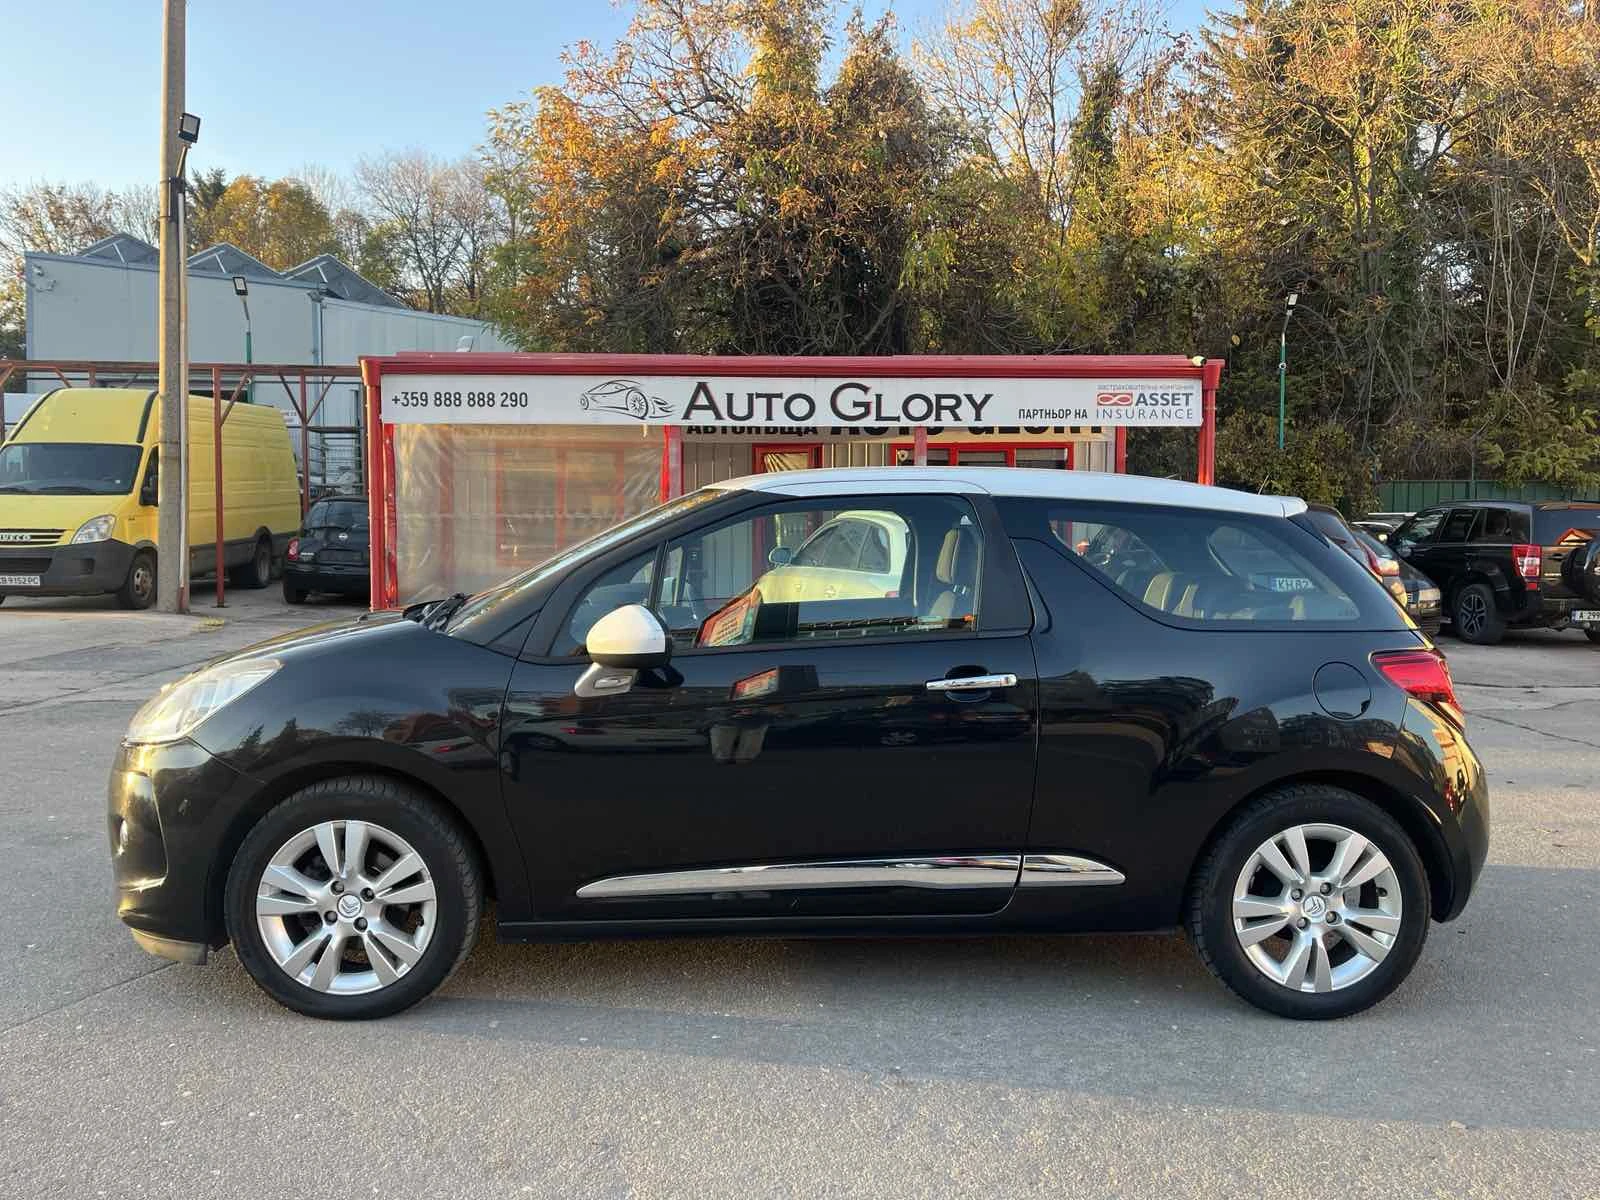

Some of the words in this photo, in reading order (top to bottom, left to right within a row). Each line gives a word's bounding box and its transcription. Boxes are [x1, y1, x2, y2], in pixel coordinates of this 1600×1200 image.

[391, 391, 428, 407] +359
[433, 391, 462, 407] 888
[467, 391, 496, 407] 888
[500, 391, 528, 407] 290
[1135, 392, 1193, 407] ASSET
[1018, 408, 1071, 420] ПАРТНЬОР
[1074, 408, 1088, 420] НА
[1096, 408, 1193, 420] INSURANCE
